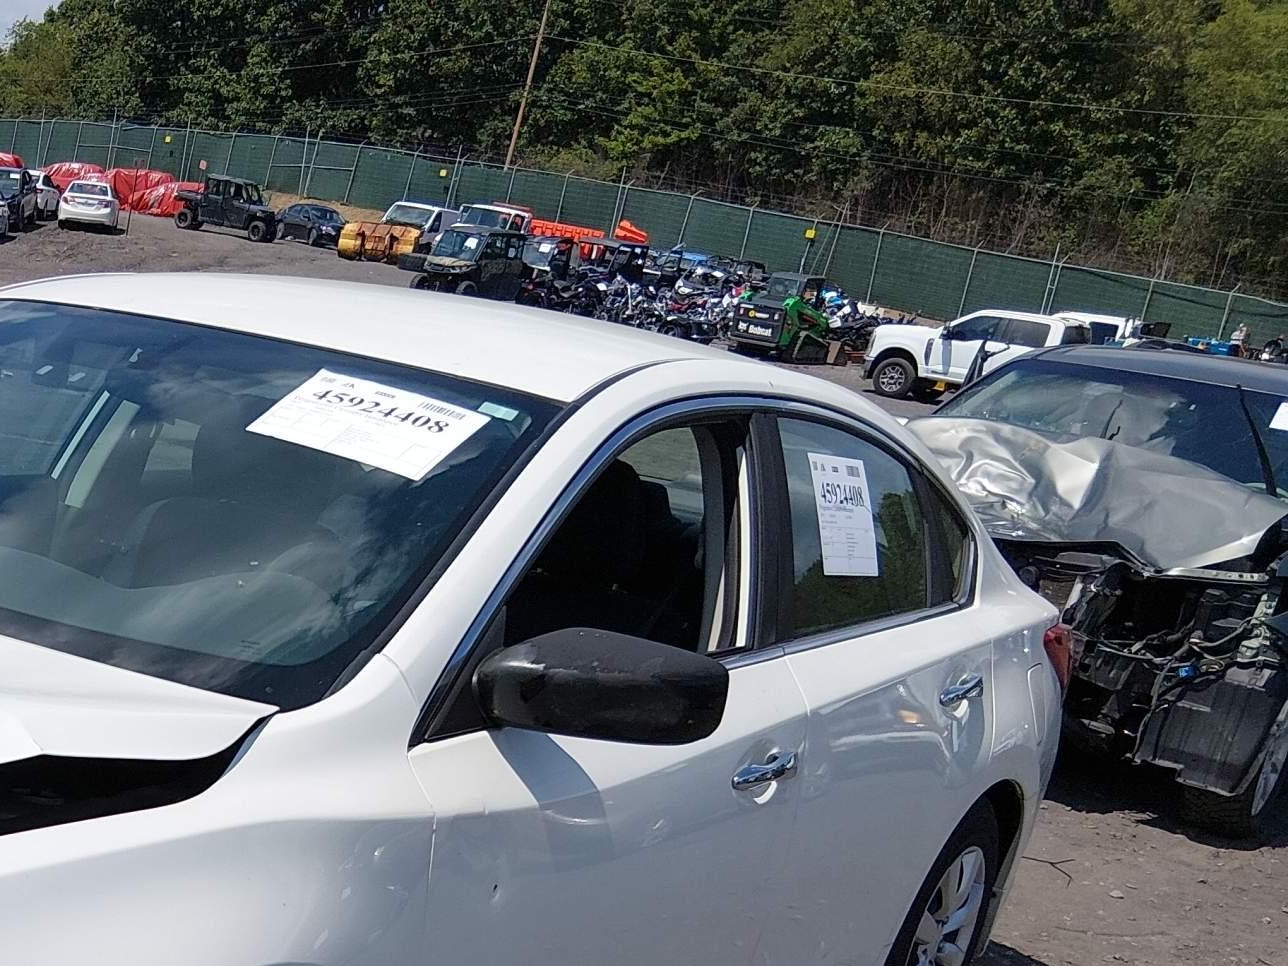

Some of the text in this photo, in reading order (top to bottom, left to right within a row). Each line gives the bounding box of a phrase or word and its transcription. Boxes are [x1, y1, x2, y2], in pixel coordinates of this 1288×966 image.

[748, 325, 772, 337] Bobcat
[313, 390, 450, 433] 45924408
[820, 481, 864, 507] 45924408
